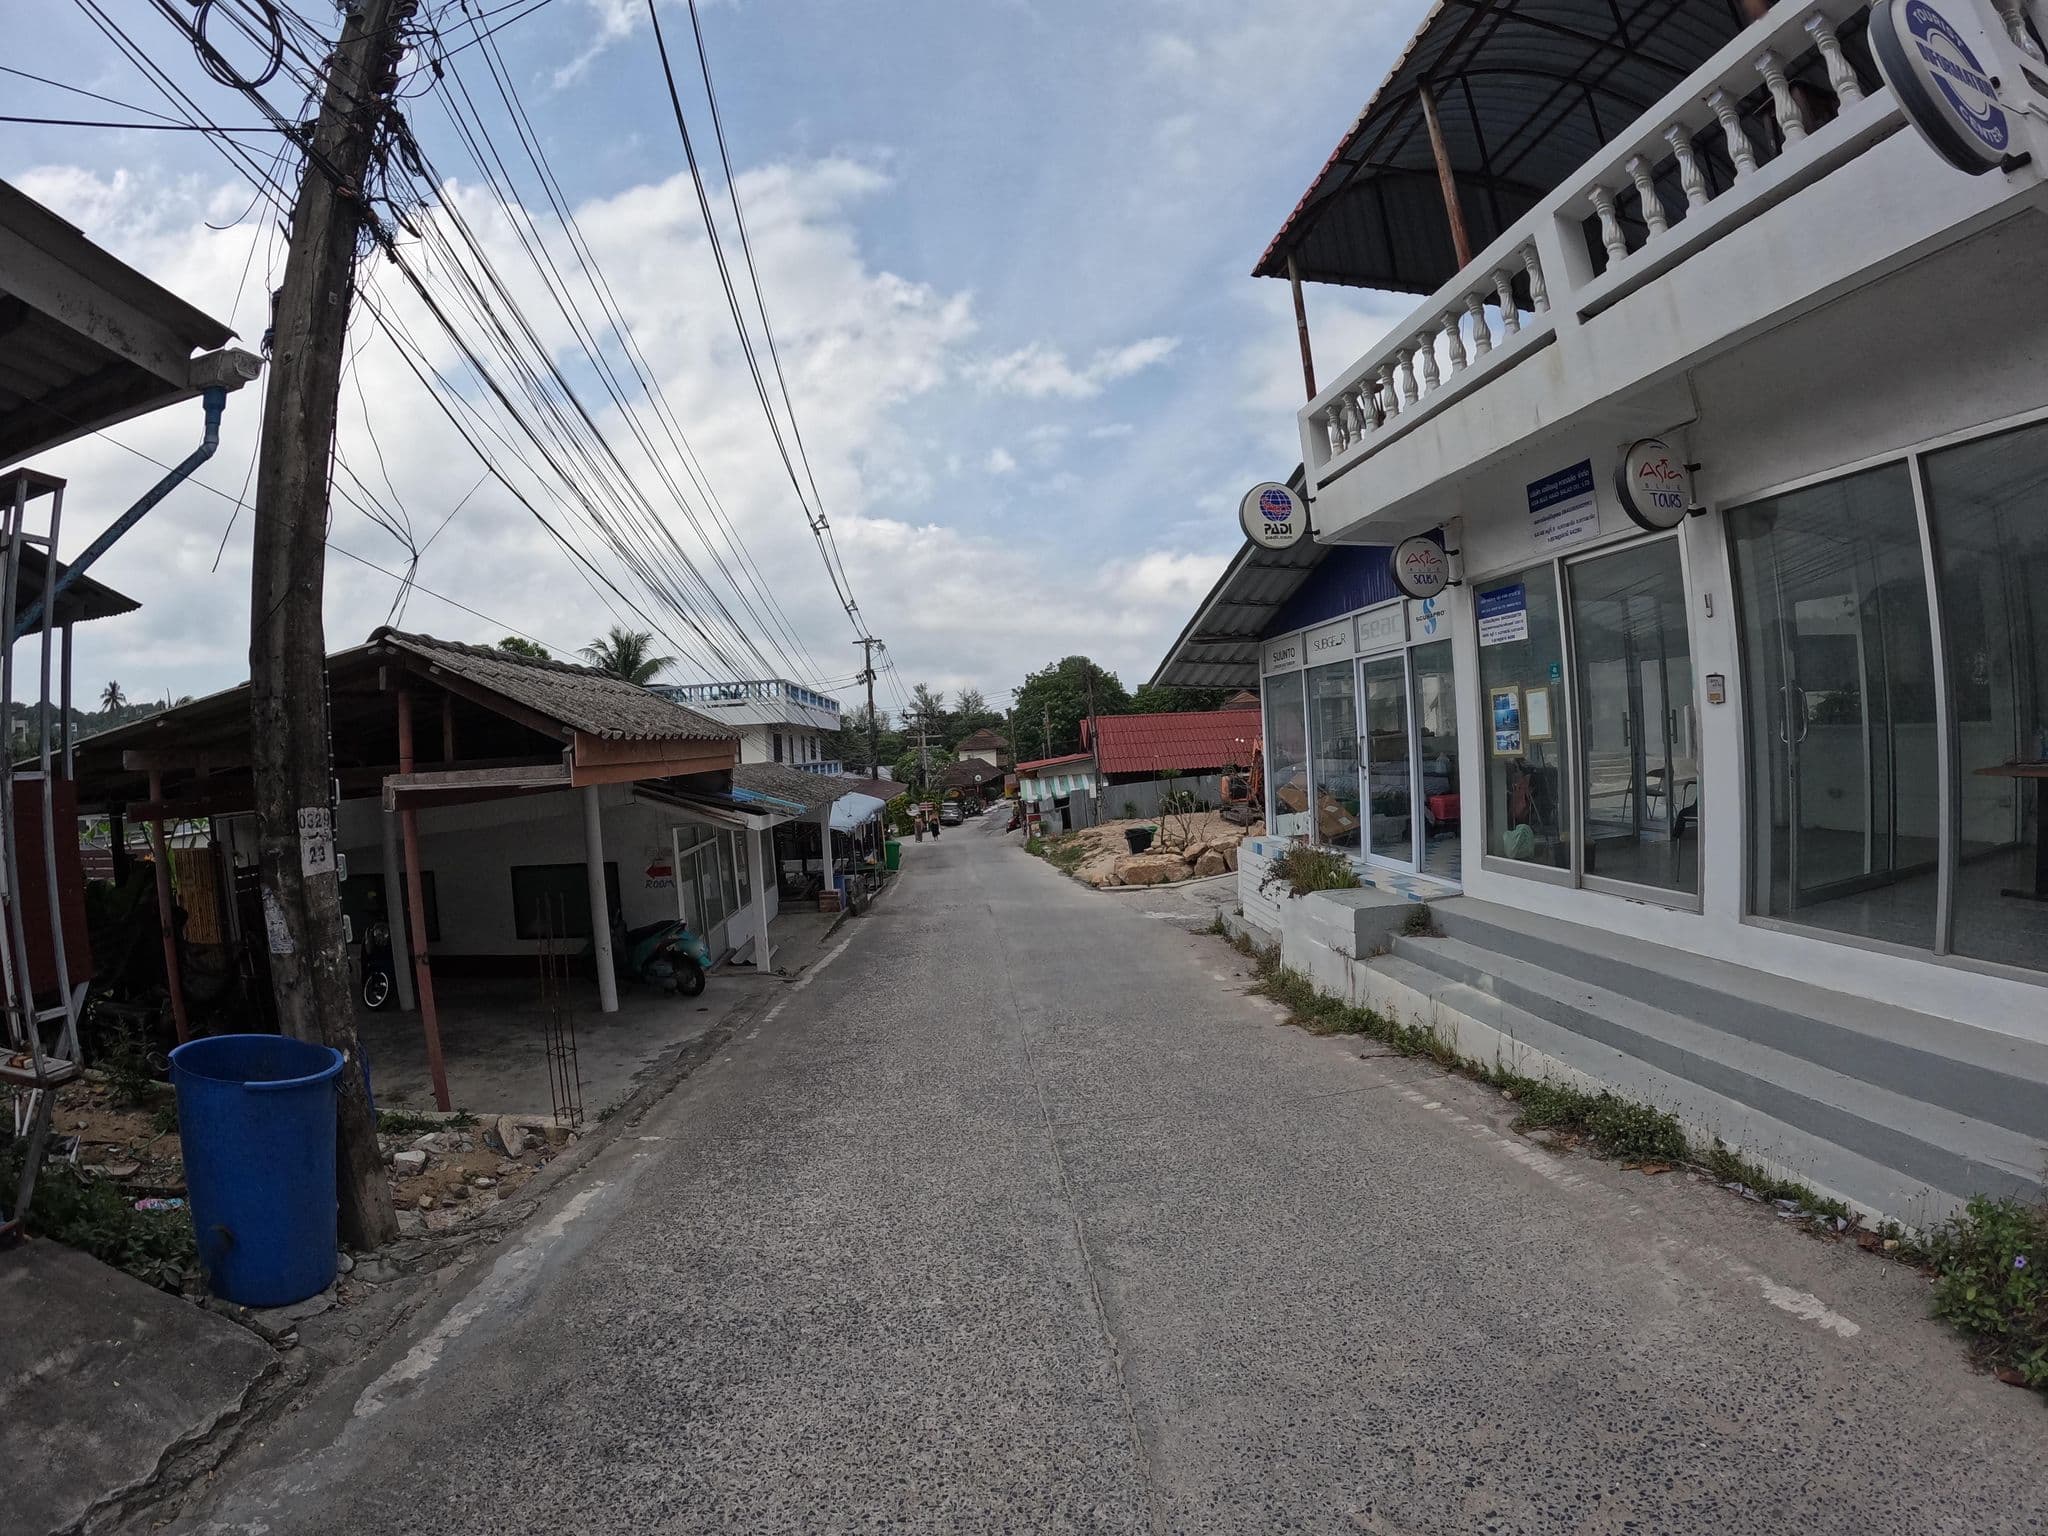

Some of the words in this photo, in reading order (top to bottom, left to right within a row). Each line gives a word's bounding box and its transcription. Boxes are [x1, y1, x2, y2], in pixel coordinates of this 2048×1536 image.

[1912, 8, 1965, 47] TOURIST
[1959, 106, 2004, 143] CENTER
[1639, 459, 1683, 483] Asia
[1650, 493, 1682, 508] TOURS
[1264, 523, 1292, 534] PADI
[1405, 550, 1442, 567] Asia
[1413, 574, 1438, 584] SCUBA
[1313, 632, 1346, 651] SUBGER
[1272, 647, 1296, 663] SUUNTO
[310, 846, 325, 864] 23
